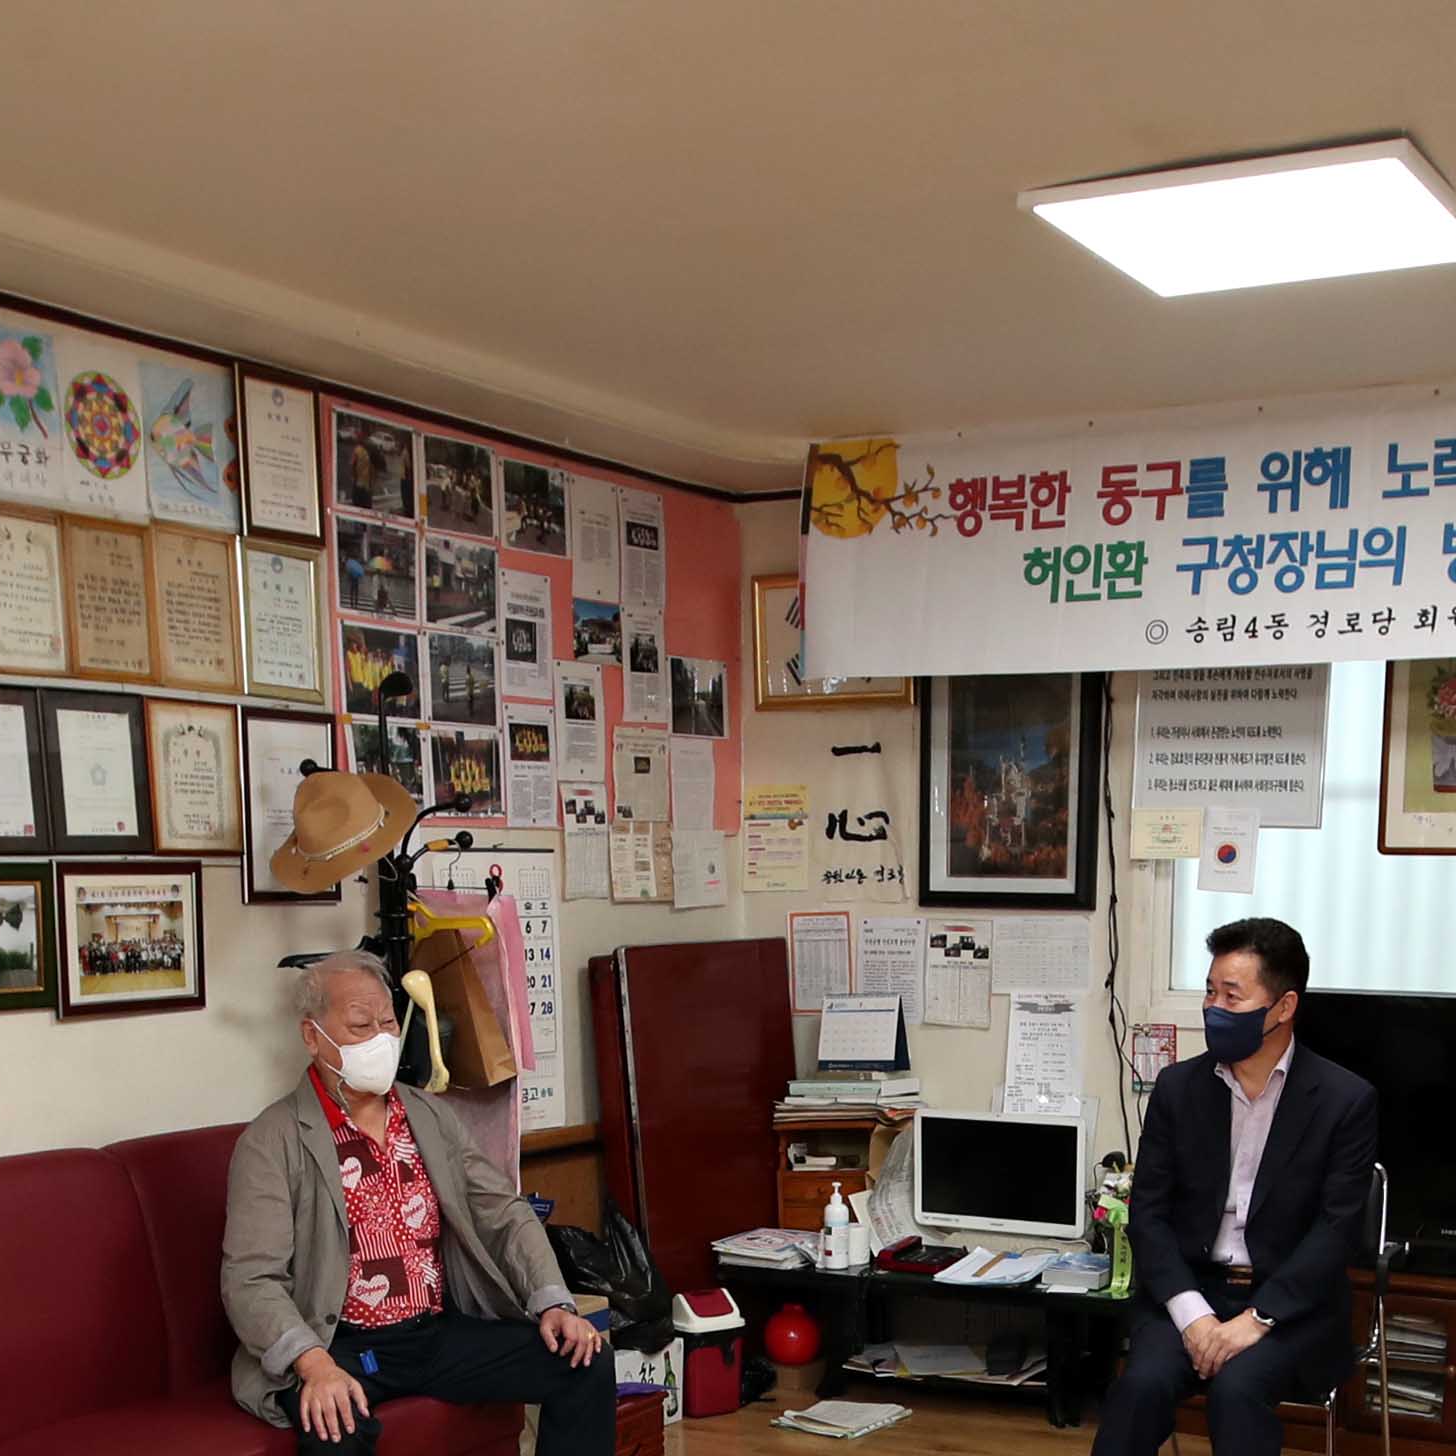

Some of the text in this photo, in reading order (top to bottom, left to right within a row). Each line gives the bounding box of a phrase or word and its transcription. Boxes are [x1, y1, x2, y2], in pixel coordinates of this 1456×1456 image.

[948, 470, 1072, 538] 행복한
[1097, 456, 1229, 526] 동구를
[1257, 446, 1352, 514] 위해
[1023, 539, 1149, 604] 허인환
[1176, 525, 1407, 596] 구청장님의
[1184, 612, 1290, 644] 송림4동
[1307, 607, 1397, 640] 경로당
[525, 920, 548, 934] 6 7
[524, 947, 551, 961] 13 14
[541, 974, 552, 988] 21
[541, 1001, 553, 1015] 28
